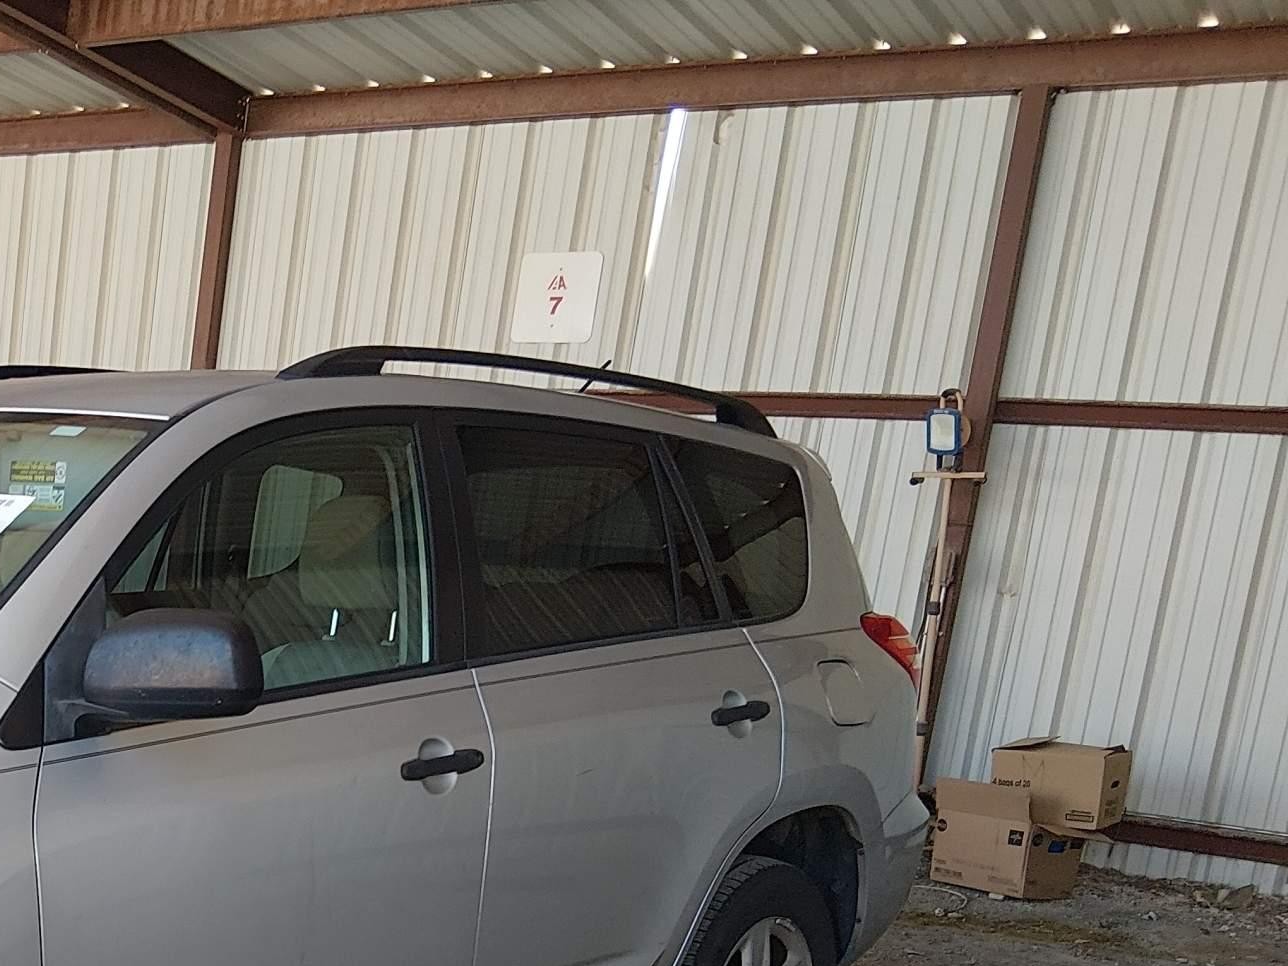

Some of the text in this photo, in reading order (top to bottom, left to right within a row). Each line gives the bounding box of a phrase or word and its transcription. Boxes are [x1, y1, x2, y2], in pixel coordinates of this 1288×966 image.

[549, 296, 564, 315] 7
[998, 779, 1013, 787] bags
[1015, 779, 1022, 787] of
